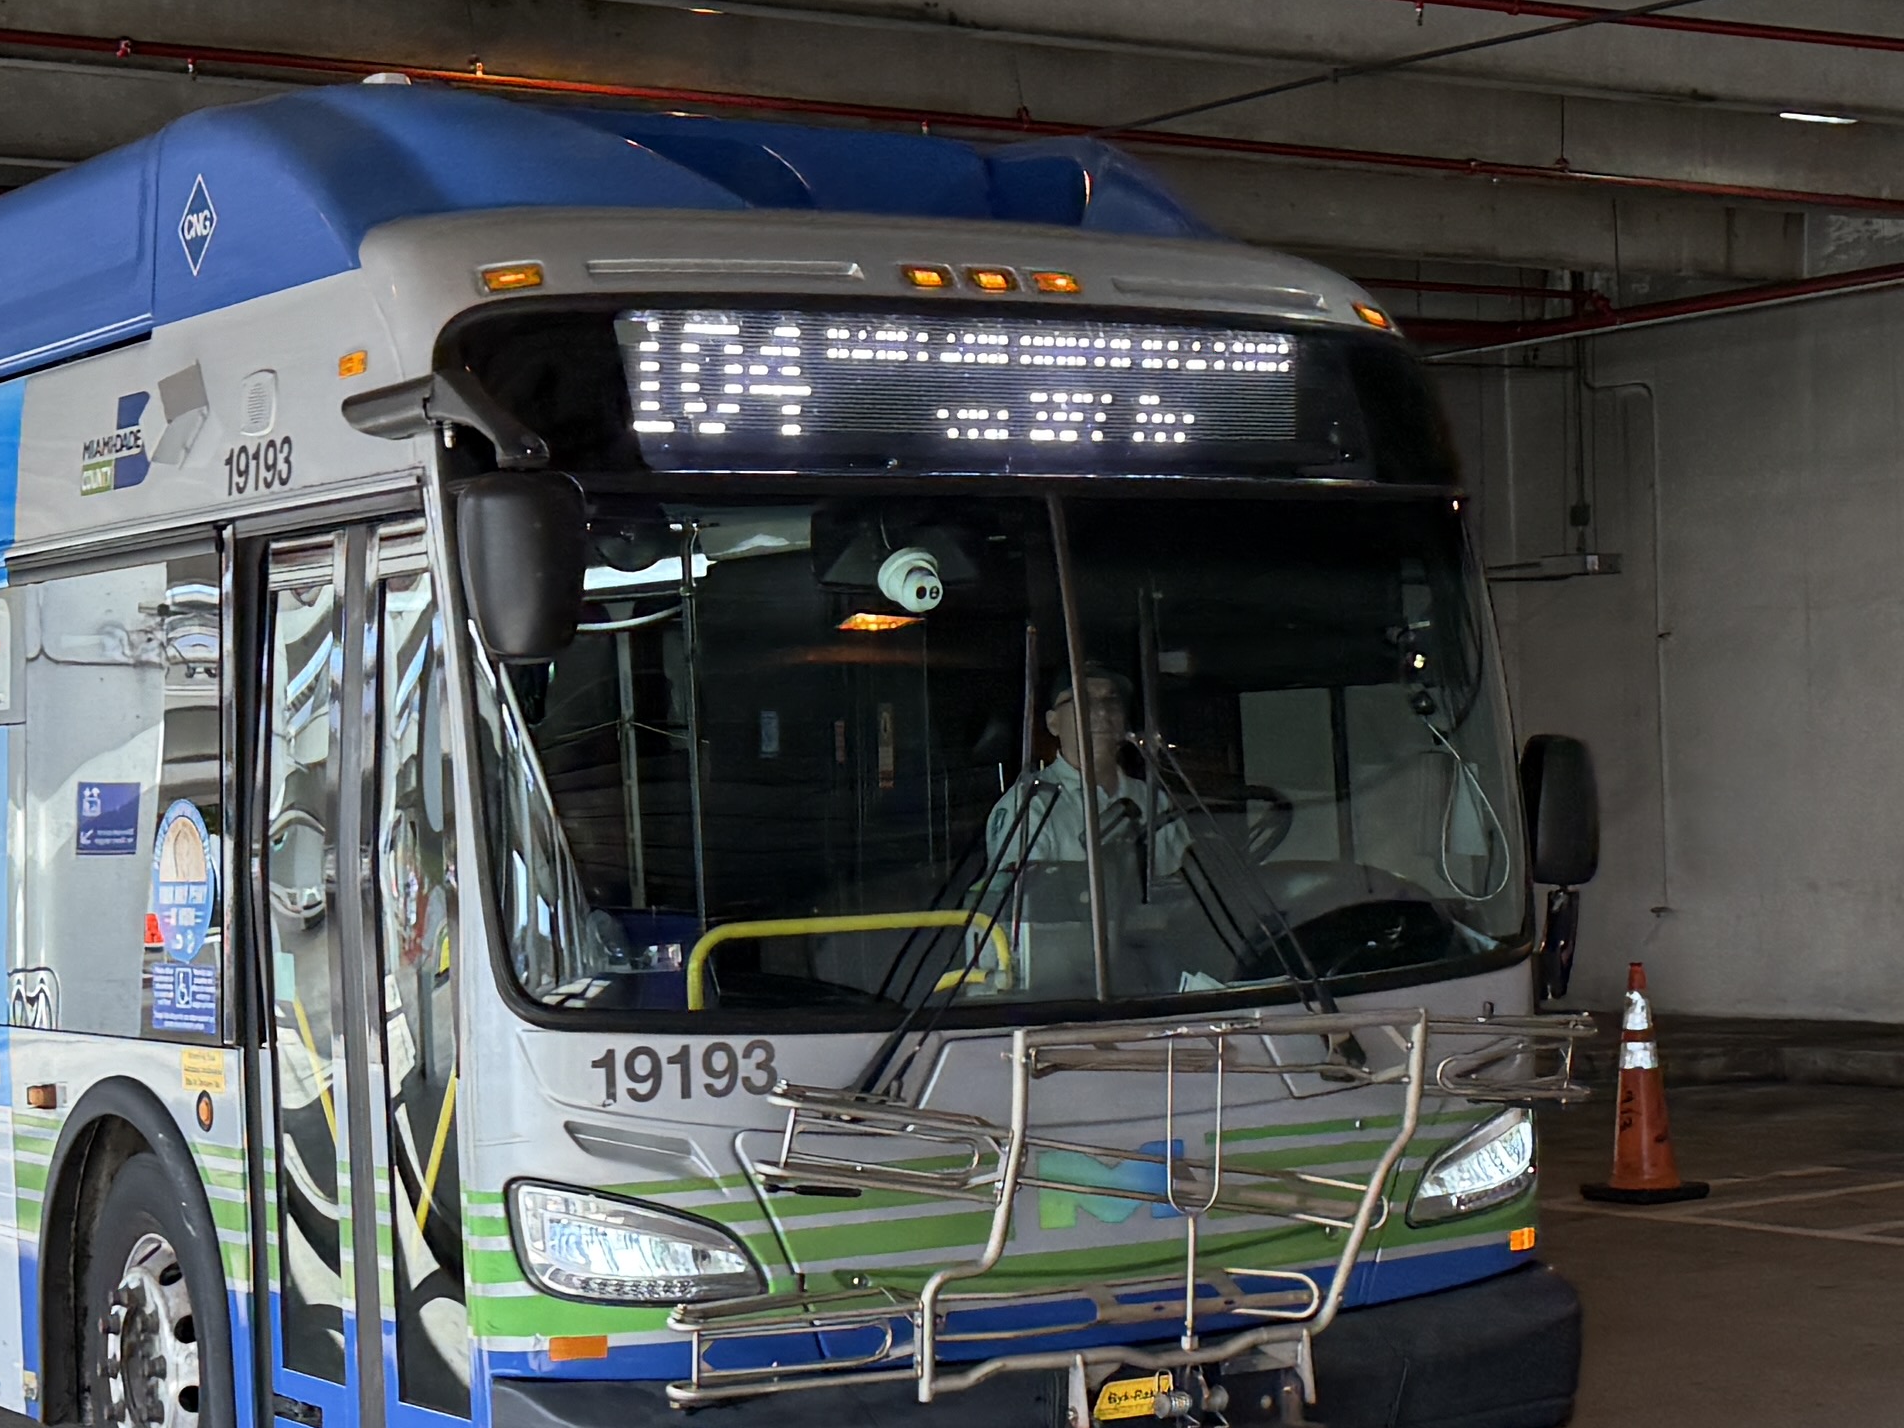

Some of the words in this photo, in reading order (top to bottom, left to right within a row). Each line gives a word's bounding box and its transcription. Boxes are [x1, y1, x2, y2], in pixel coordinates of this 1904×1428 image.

[184, 210, 210, 240] CNG
[632, 323, 812, 436] 104
[224, 435, 293, 496] 19193
[591, 1039, 778, 1104] 19193
